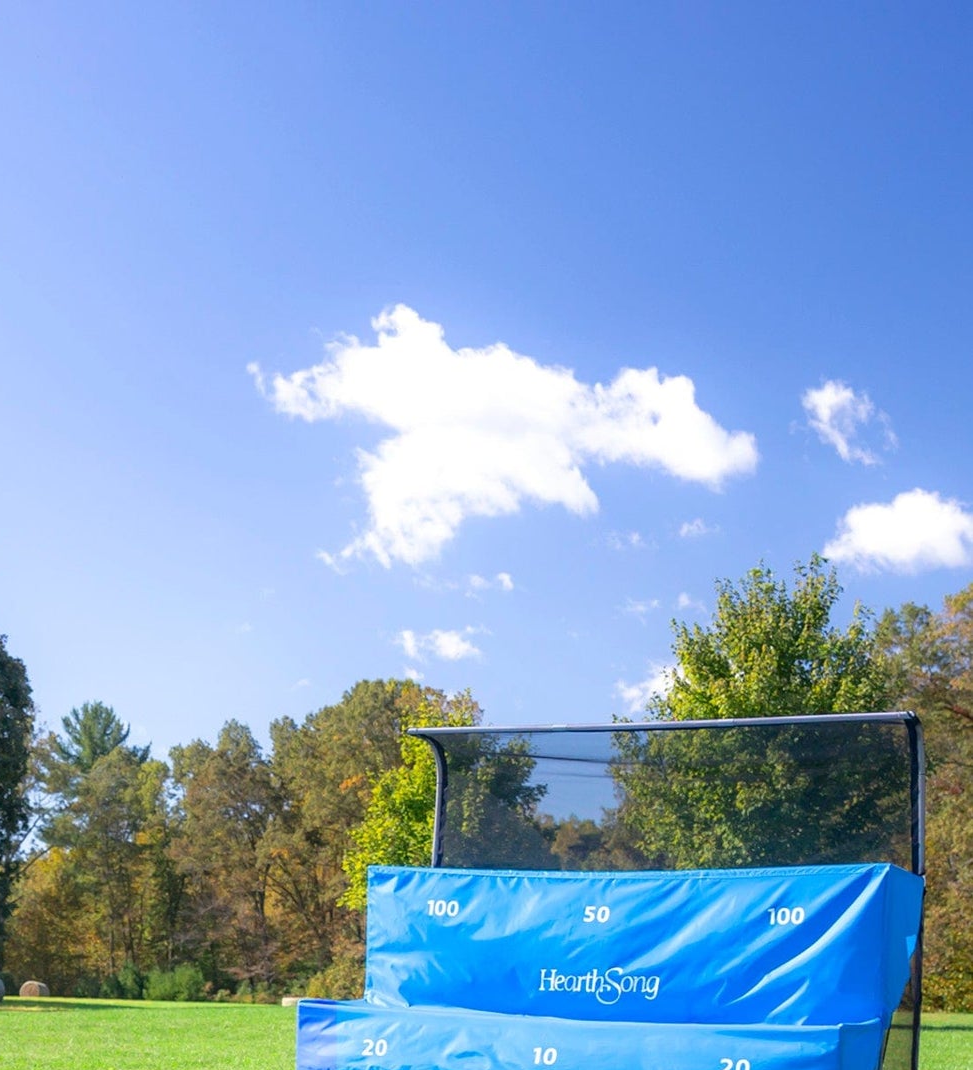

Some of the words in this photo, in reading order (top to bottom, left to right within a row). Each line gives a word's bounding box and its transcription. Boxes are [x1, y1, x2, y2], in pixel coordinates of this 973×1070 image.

[427, 899, 459, 917] 100
[583, 906, 610, 923] 50
[768, 907, 805, 925] 100
[539, 967, 660, 1004] HearthSong
[362, 1039, 388, 1056] 20
[533, 1047, 557, 1065] 10
